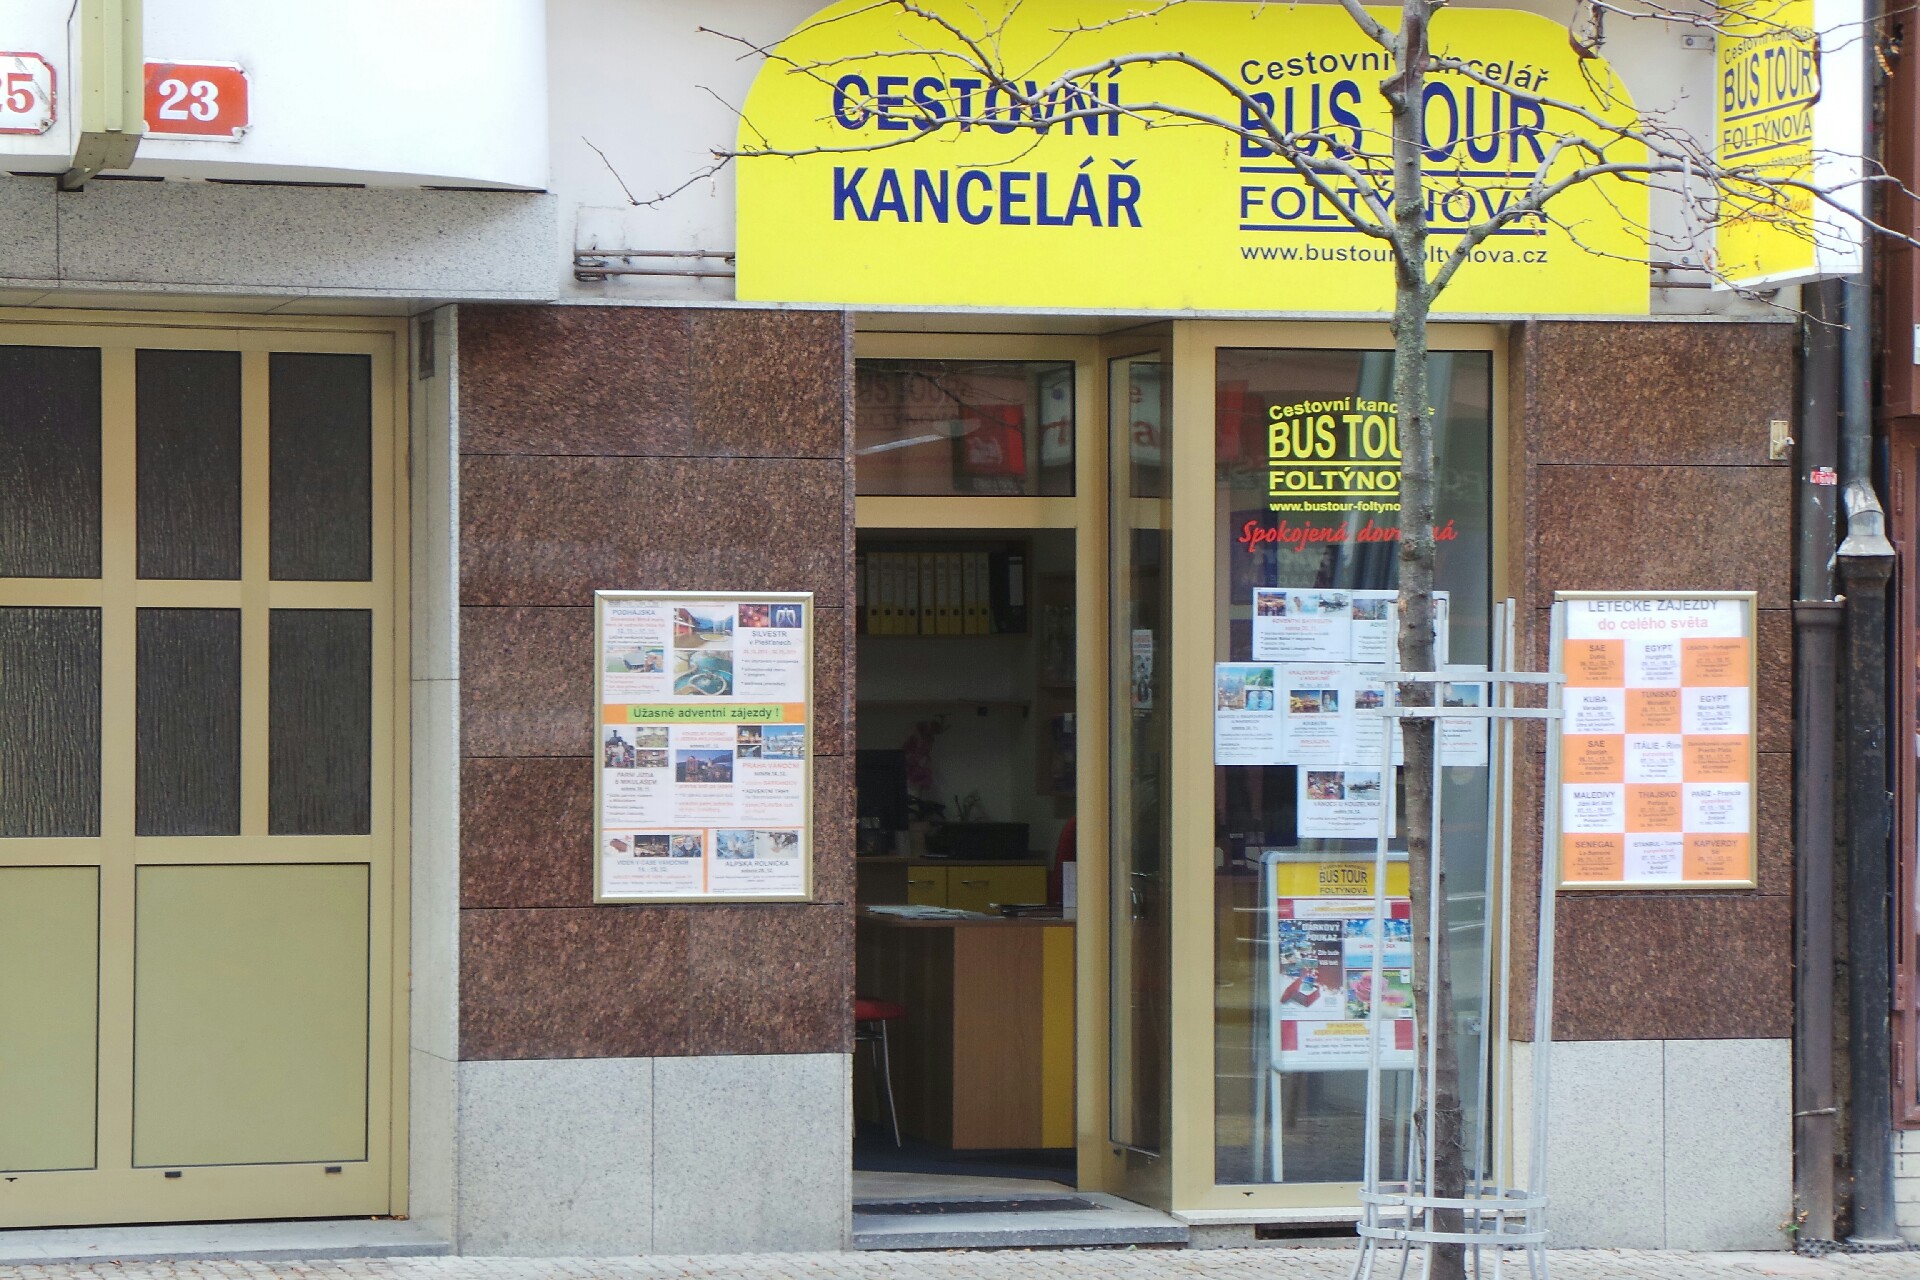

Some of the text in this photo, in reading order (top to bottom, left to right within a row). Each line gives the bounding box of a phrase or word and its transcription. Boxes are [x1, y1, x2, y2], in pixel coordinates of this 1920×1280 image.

[1724, 46, 1812, 112] BUS TOUR
[0, 72, 34, 113] 5
[158, 79, 219, 122] 23
[832, 66, 1122, 137] CESTOVNÍ
[1240, 79, 1546, 164] BUS OUR
[832, 155, 1143, 228] KANCELÁŘ
[1269, 397, 1350, 420] Cestovní
[1269, 415, 1403, 458] BUS TOU
[1269, 466, 1402, 490] FOLTÝNO
[1239, 520, 1349, 553] Spokojená
[1597, 617, 1709, 630] do celého světa
[1645, 644, 1672, 653] EGYPT
[1700, 695, 1728, 703] EGYPT
[633, 705, 675, 718] Úžasné
[678, 707, 726, 718] adventní
[731, 707, 772, 720] zájezdy
[1587, 740, 1606, 748] SAE
[1573, 791, 1615, 799] MALEDIVY
[1638, 790, 1678, 799] THAJSKO
[1319, 869, 1368, 884] BUS TOUR
